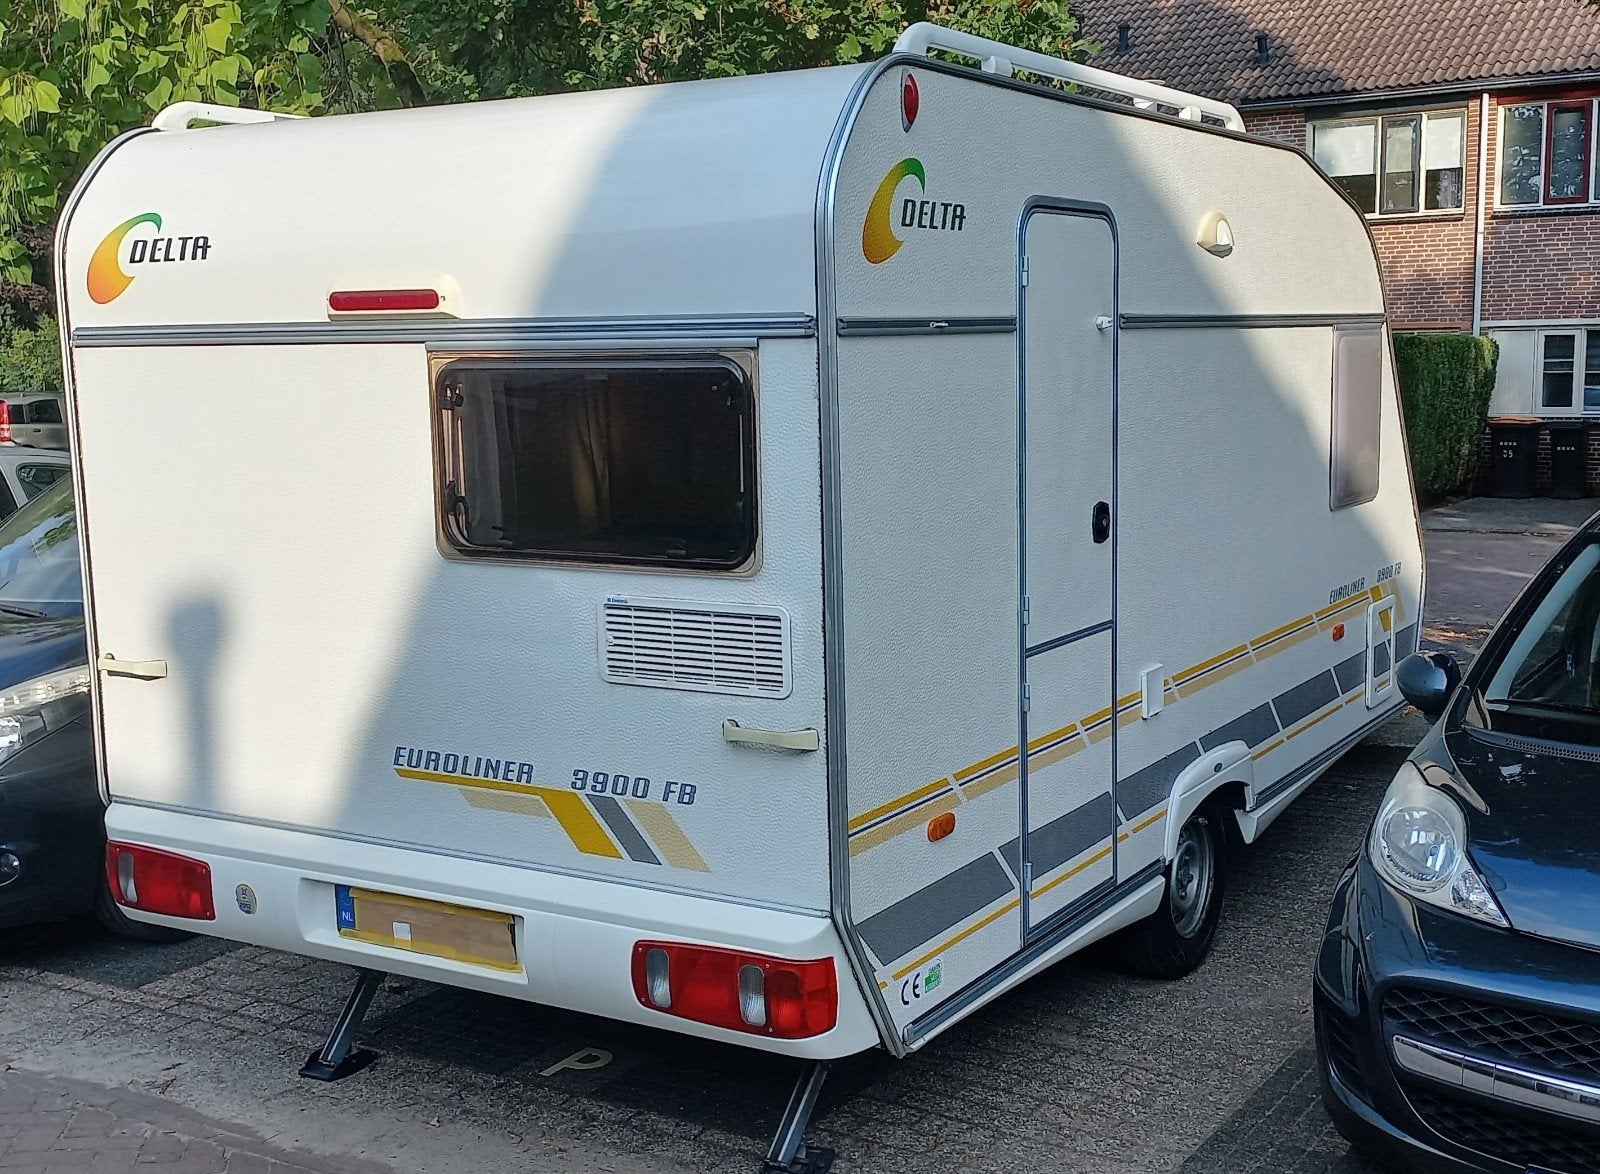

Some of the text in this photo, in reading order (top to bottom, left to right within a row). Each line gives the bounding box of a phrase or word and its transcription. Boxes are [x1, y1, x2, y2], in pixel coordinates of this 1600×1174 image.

[901, 198, 966, 231] DELTA
[129, 236, 211, 264] DELTA
[1329, 577, 1365, 605] EUROLINER
[393, 746, 698, 806] EUROLINER 3900 FB
[341, 911, 354, 922] NL
